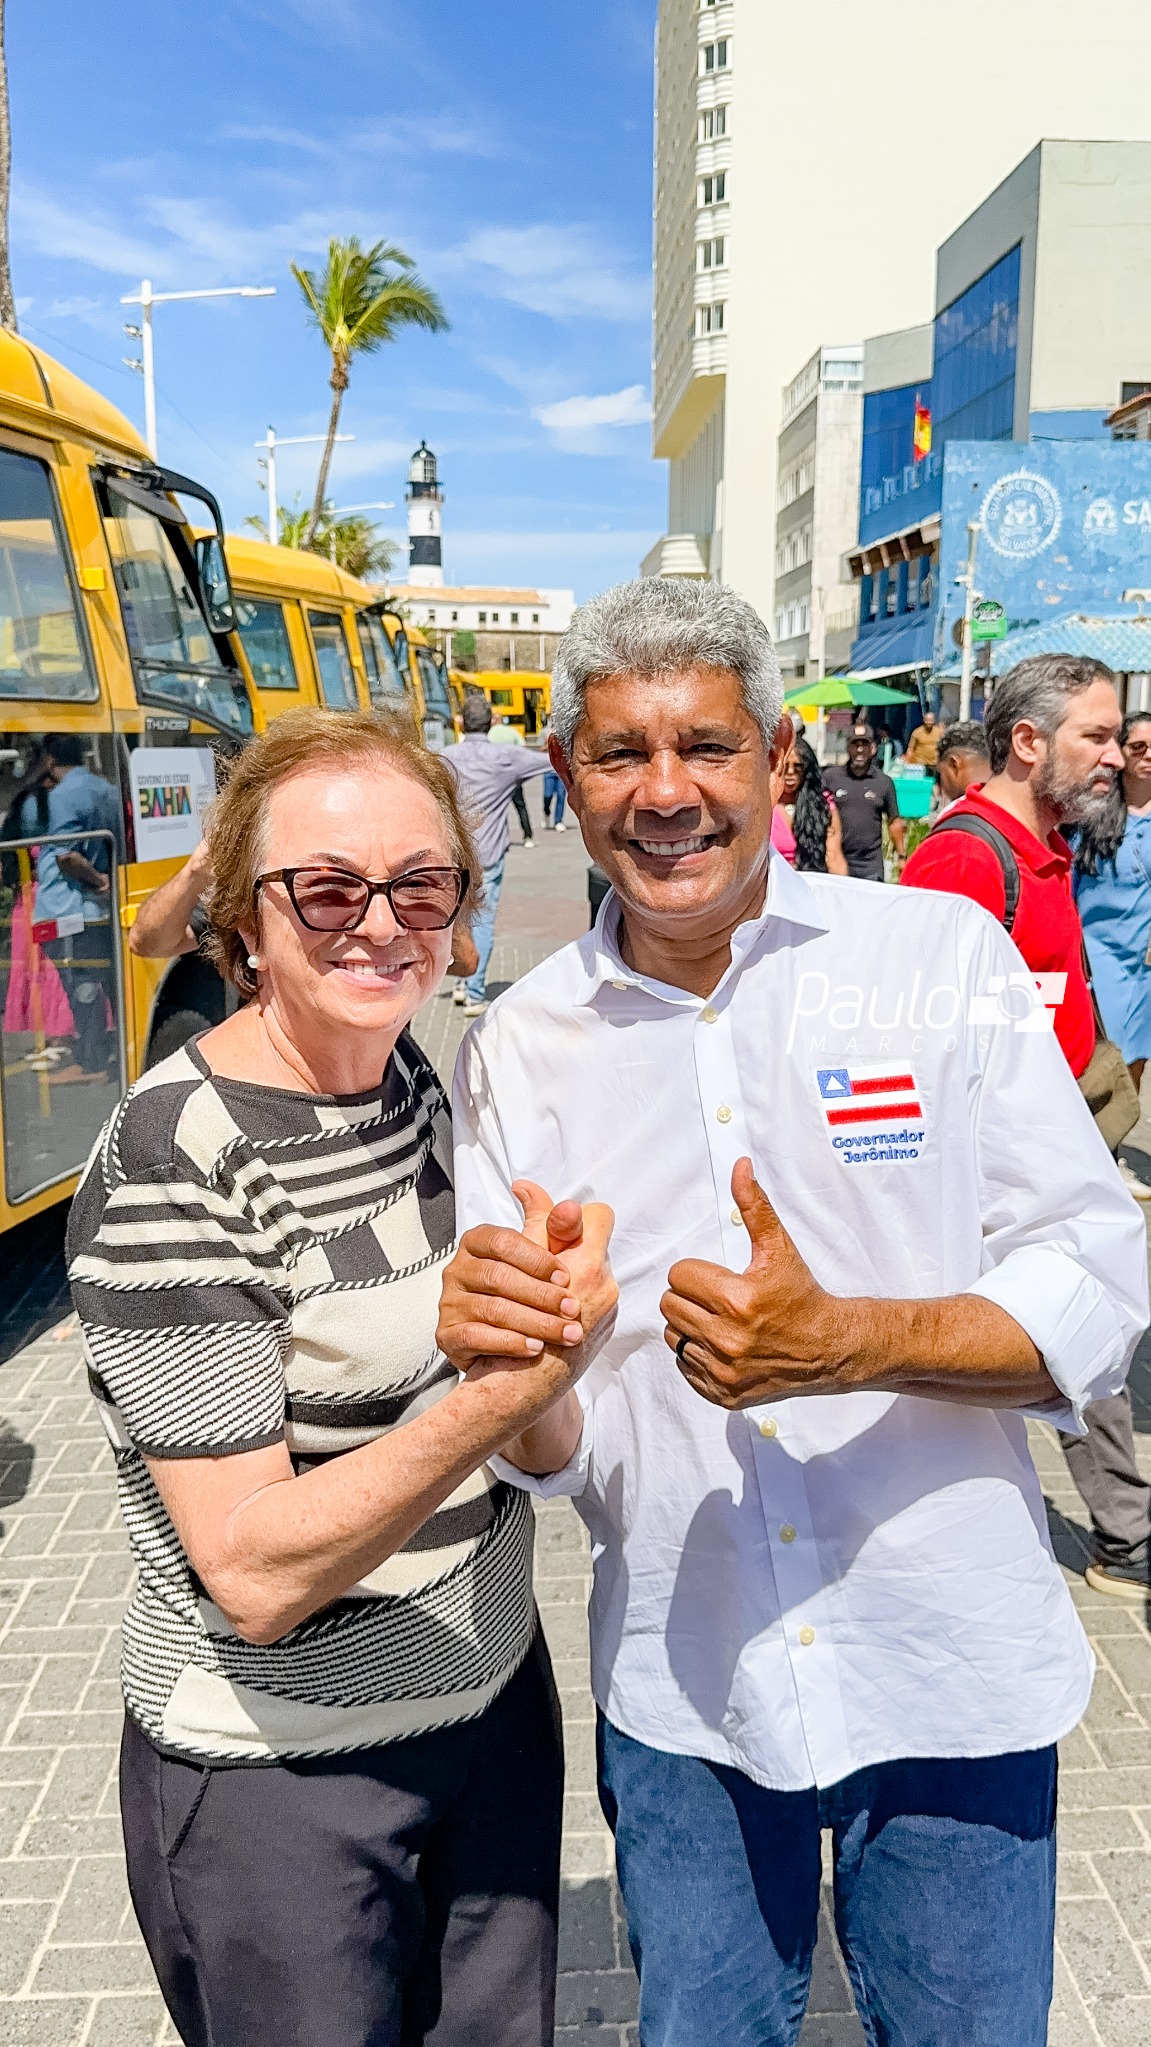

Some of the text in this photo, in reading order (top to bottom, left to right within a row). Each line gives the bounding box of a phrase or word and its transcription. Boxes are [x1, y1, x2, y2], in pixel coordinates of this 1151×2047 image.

[146, 718, 189, 731] THUNDER
[137, 775, 162, 785] GOVERNO
[139, 785, 192, 819] BAHIA
[831, 1128, 925, 1149] Governador
[843, 1146, 919, 1164] Jerônimo
